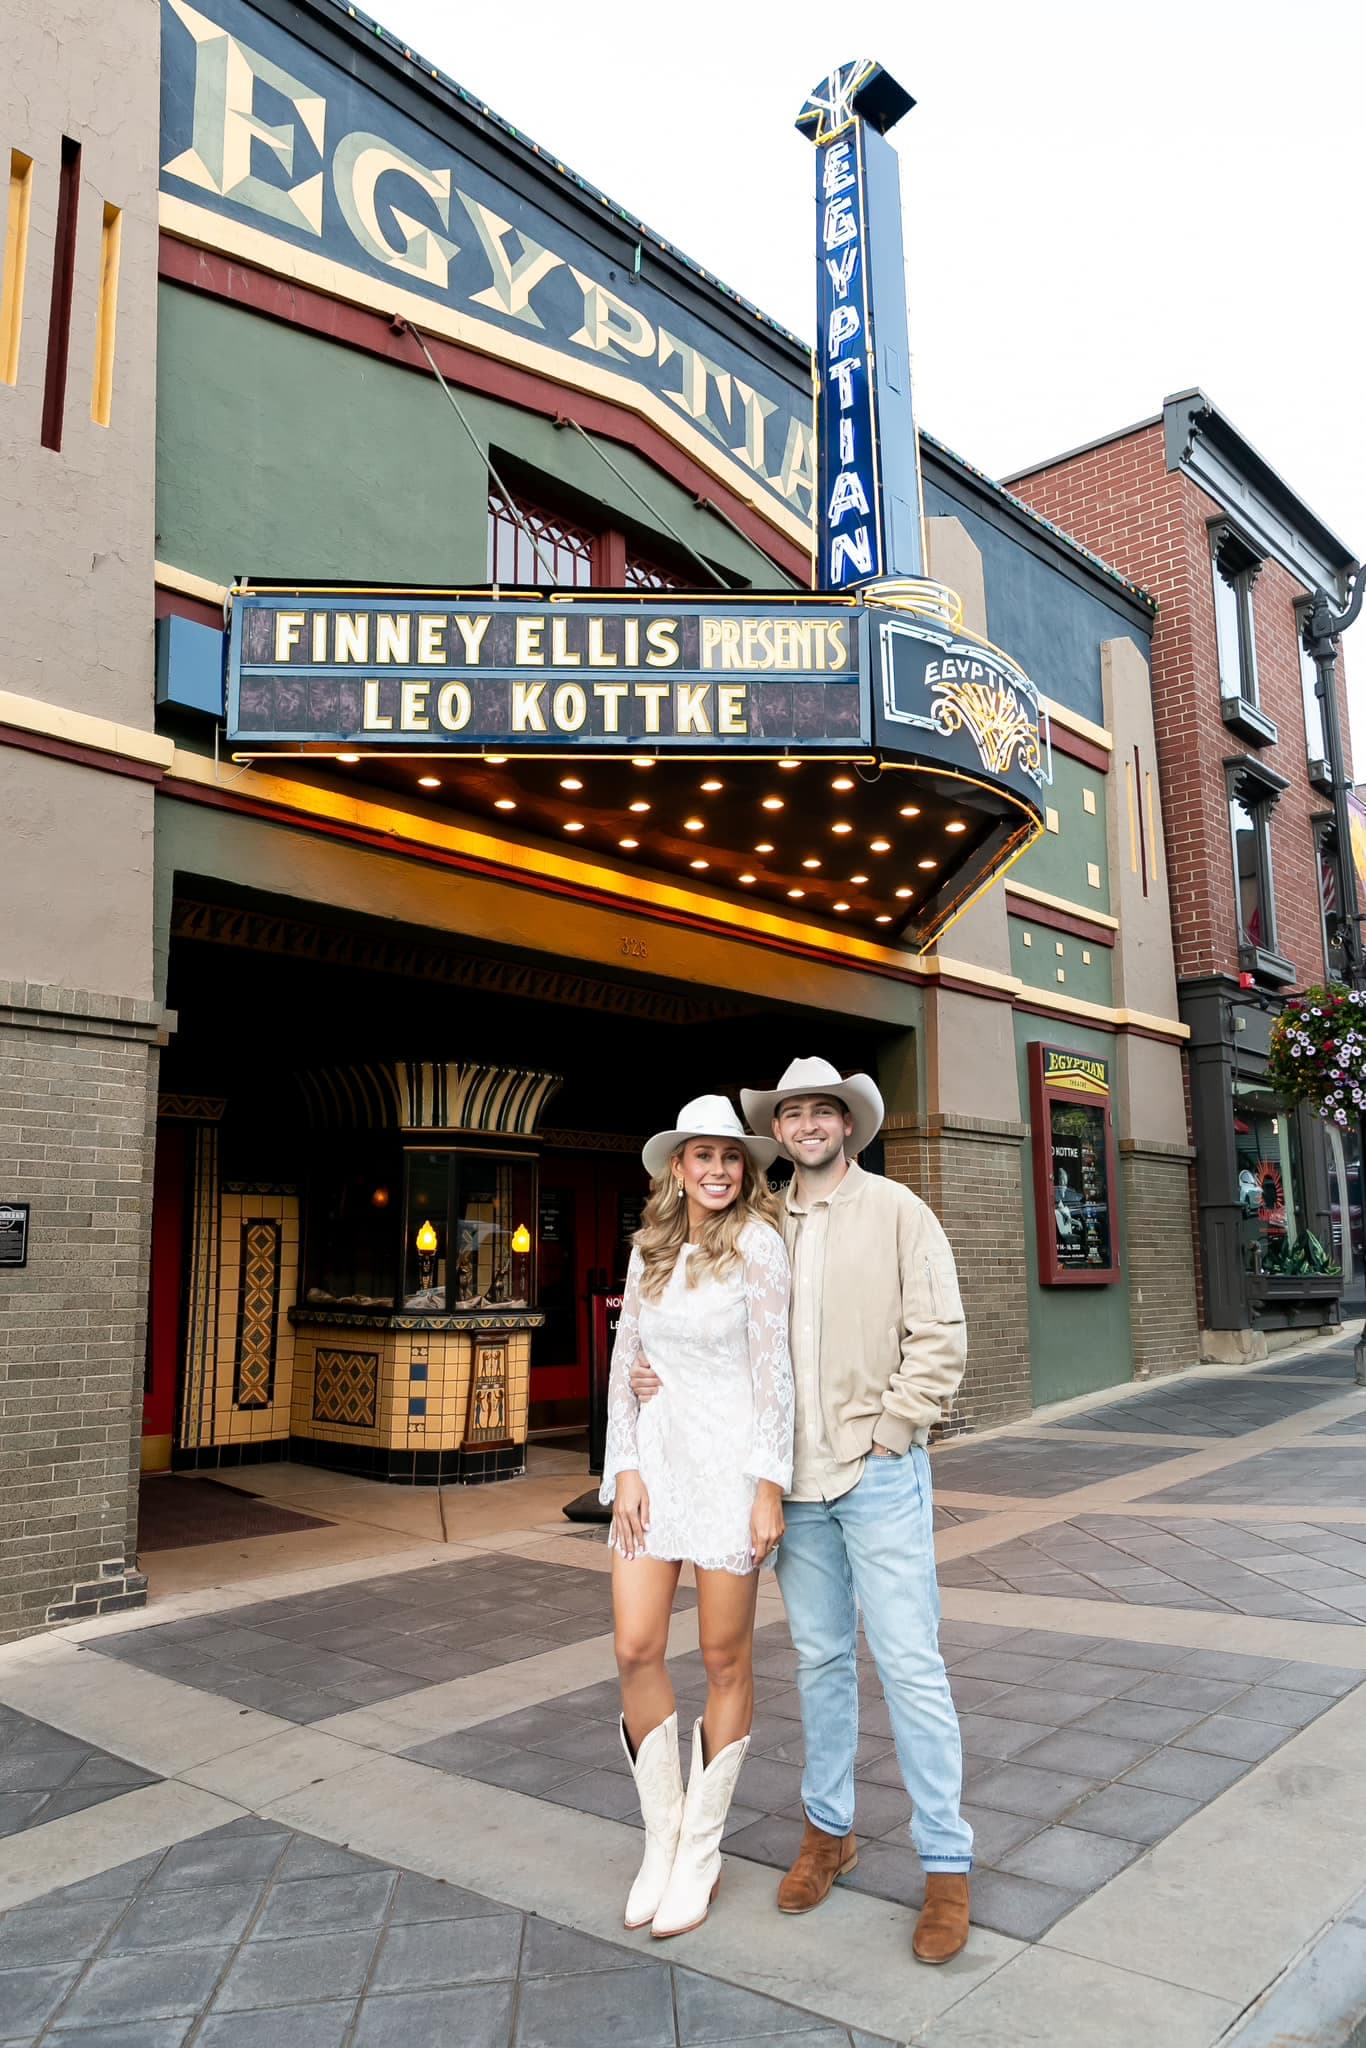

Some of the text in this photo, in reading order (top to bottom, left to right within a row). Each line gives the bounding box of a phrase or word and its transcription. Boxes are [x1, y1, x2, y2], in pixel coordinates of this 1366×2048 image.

[161, 0, 818, 522] EGYPTIA
[823, 141, 873, 584] EGYPTIAN
[274, 611, 848, 670] FINNEY ELLIS PRESENTS
[362, 679, 748, 734] LEO KOTTKE
[620, 936, 648, 958] 328
[1048, 1052, 1105, 1081] EGYPTIAN
[1055, 1146, 1079, 1158] KOTTKE
